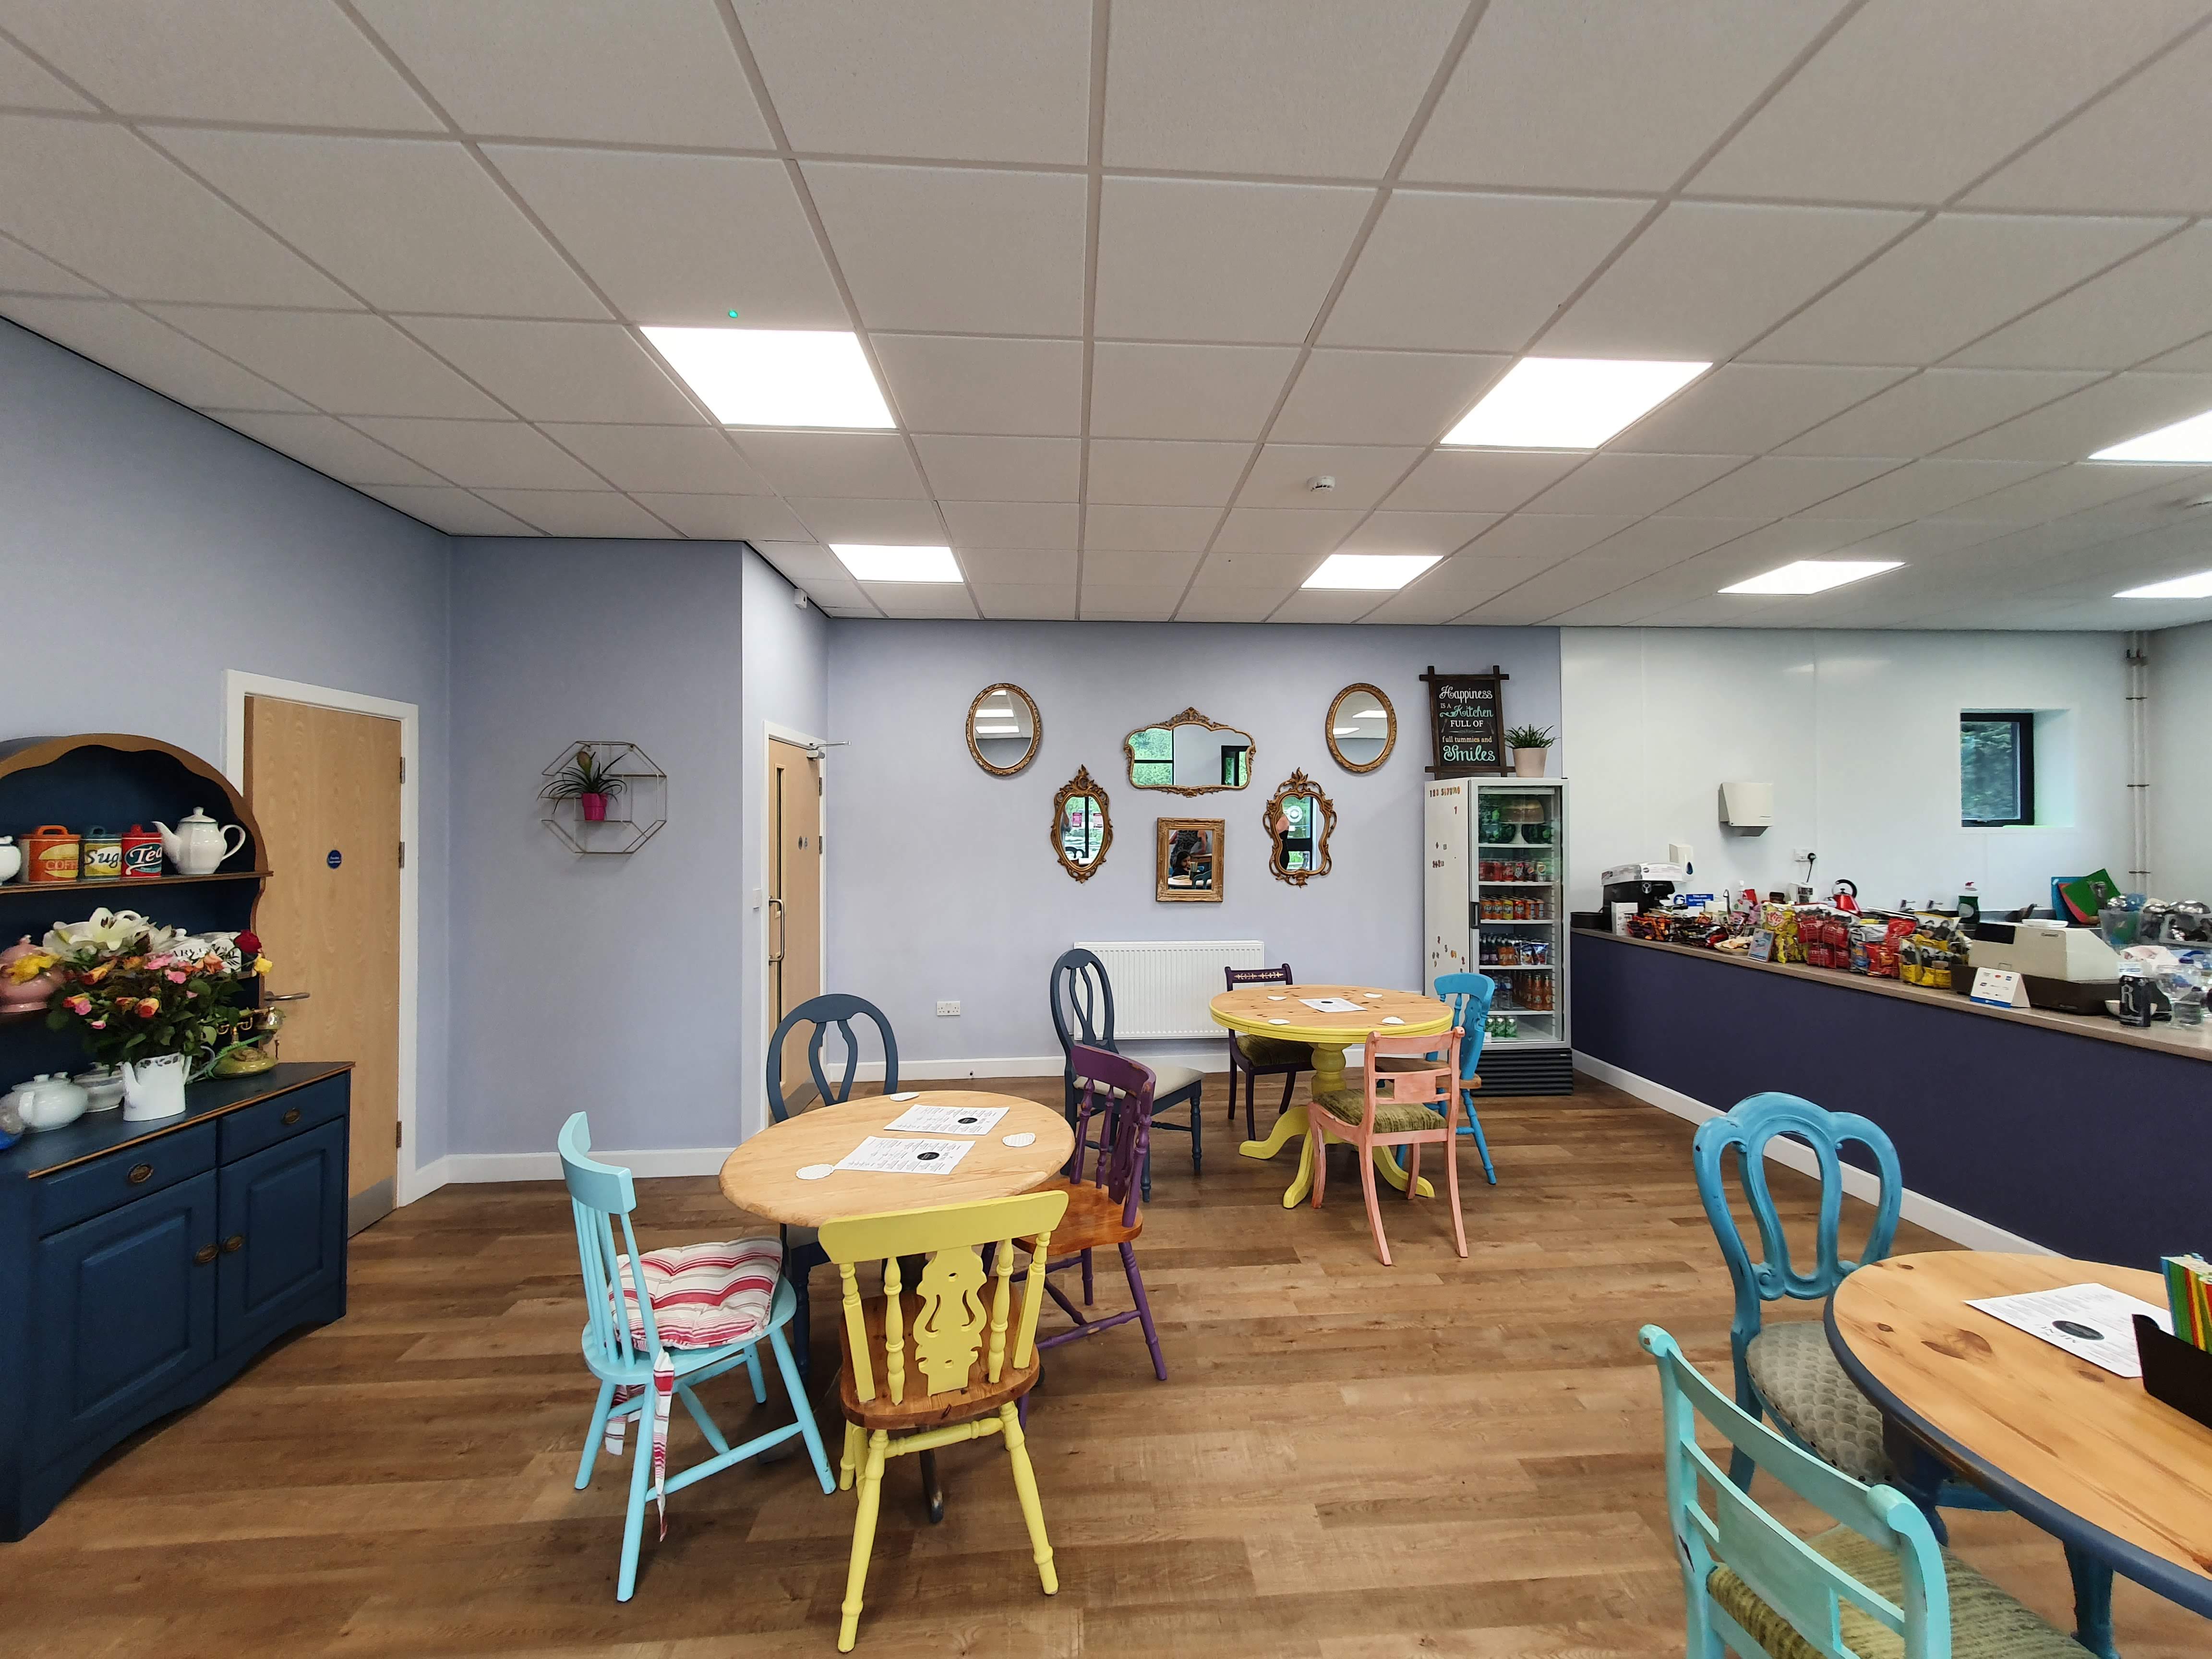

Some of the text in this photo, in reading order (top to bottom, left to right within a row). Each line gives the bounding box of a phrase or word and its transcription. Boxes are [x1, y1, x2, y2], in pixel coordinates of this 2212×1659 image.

[1439, 685, 1493, 704] Happiness
[1451, 704, 1494, 717] Kitchen
[1443, 745, 1495, 761] Smiles
[86, 849, 122, 868] Sug
